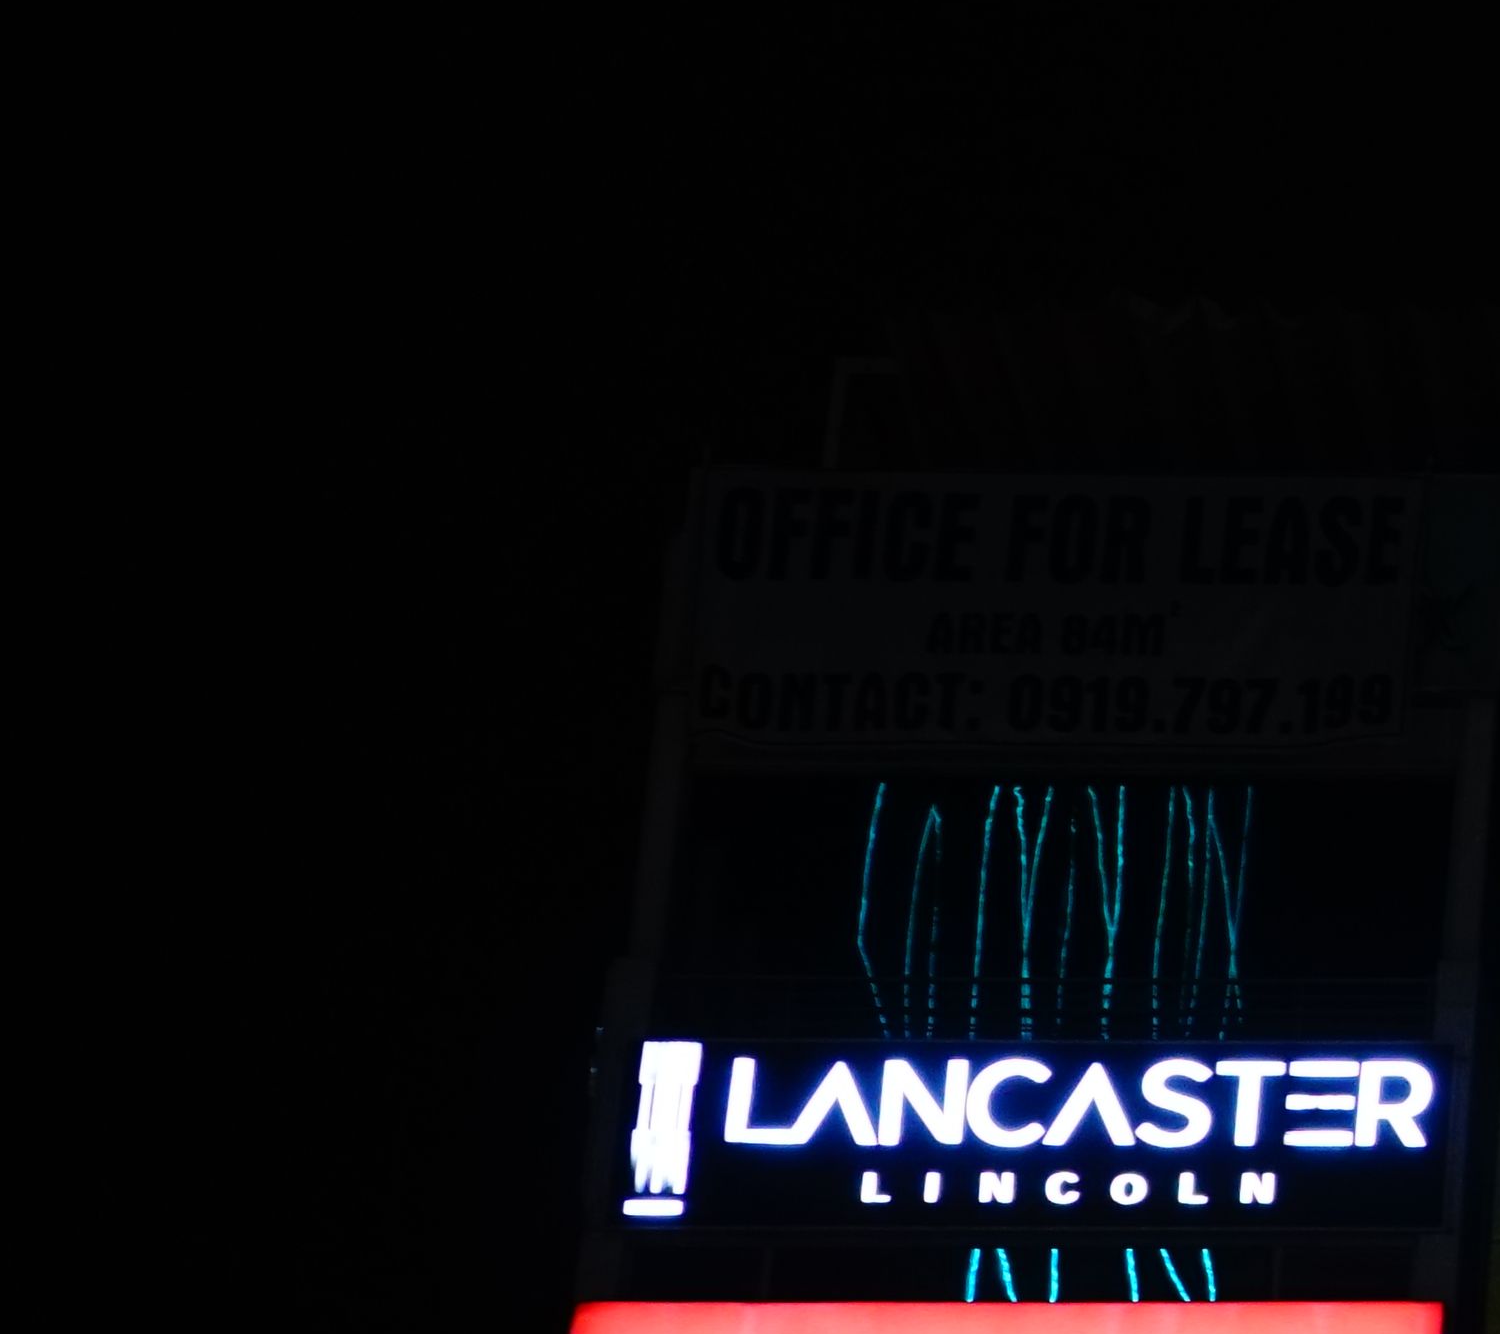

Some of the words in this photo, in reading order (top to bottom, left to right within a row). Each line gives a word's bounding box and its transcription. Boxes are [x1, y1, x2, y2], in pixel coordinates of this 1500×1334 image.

[713, 486, 983, 584] OFFICE
[1003, 492, 1154, 586] FOR
[1177, 494, 1407, 588] LEASE
[924, 610, 1043, 656] AREA
[698, 662, 986, 733] CONTACT:
[1006, 671, 1395, 735] 0919.797.199
[723, 1056, 1436, 1149] LANCASTER
[860, 1171, 1277, 1205] LINCOLN
